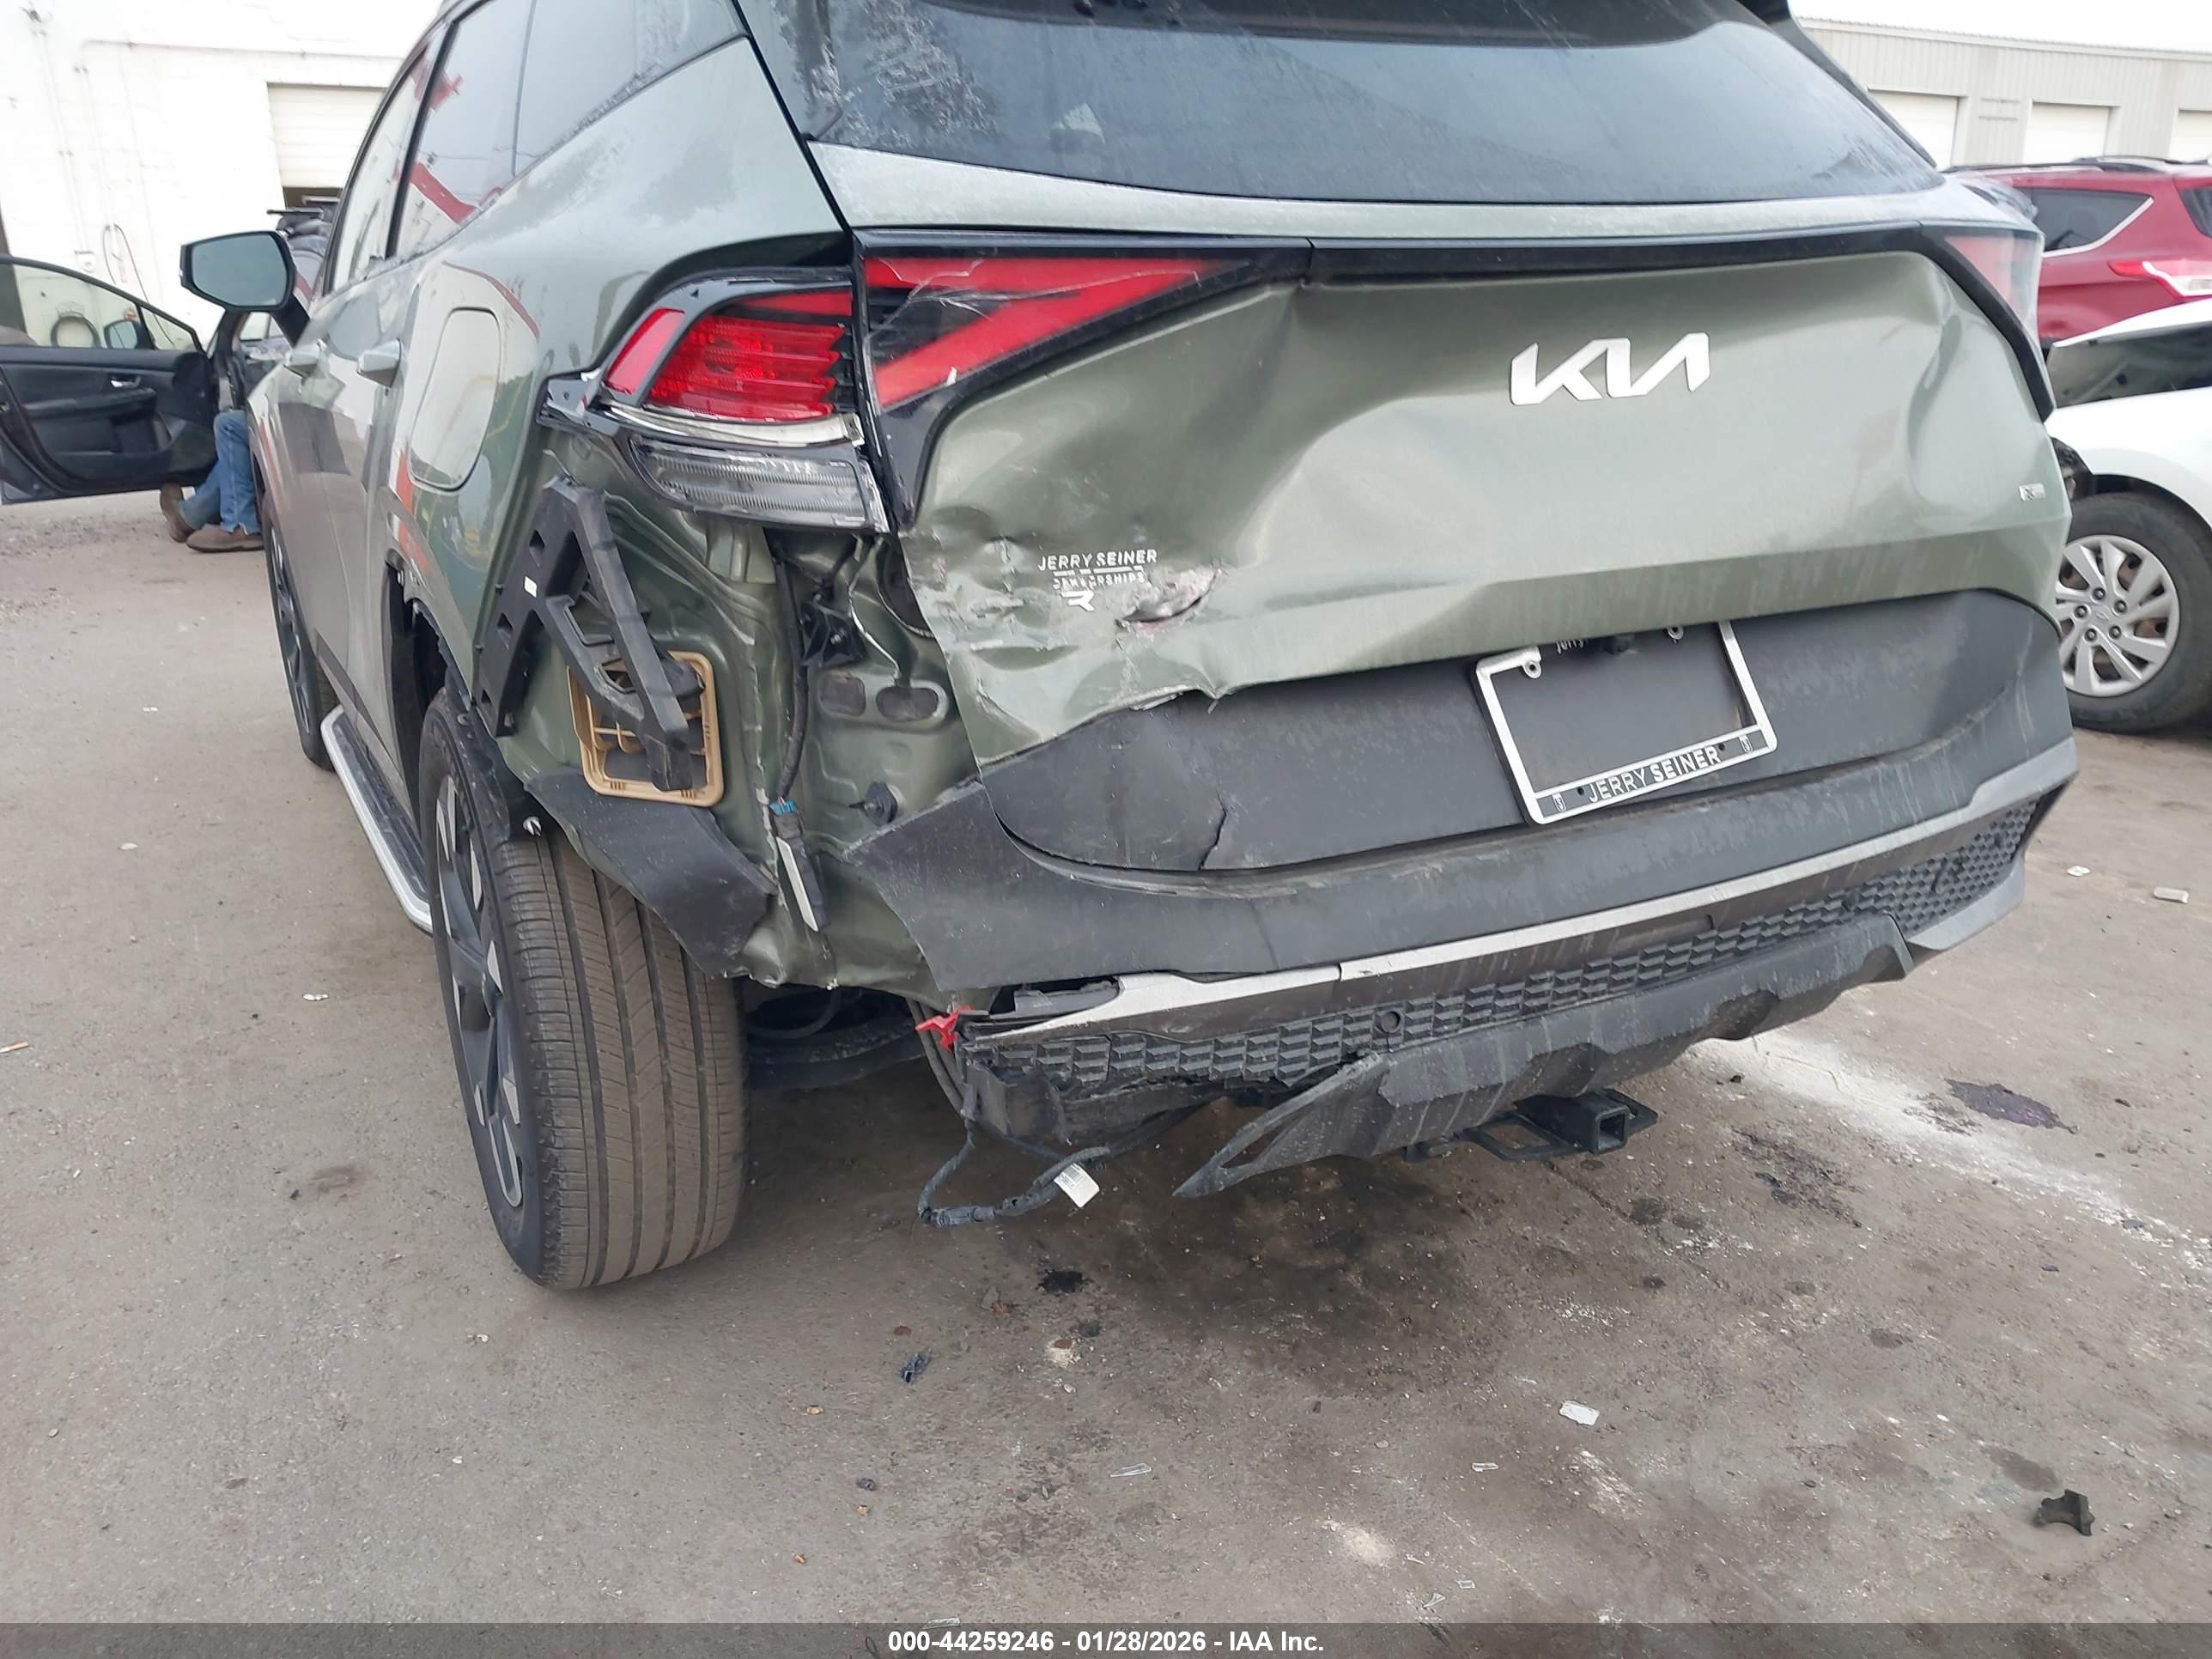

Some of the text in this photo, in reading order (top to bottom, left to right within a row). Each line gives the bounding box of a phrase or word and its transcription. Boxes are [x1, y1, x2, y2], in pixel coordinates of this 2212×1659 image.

[1510, 331, 1711, 406] KIA
[1037, 549, 1158, 571] JERRY SEINER
[1588, 767, 1648, 804] JERRY
[1650, 745, 1722, 783] SEINER
